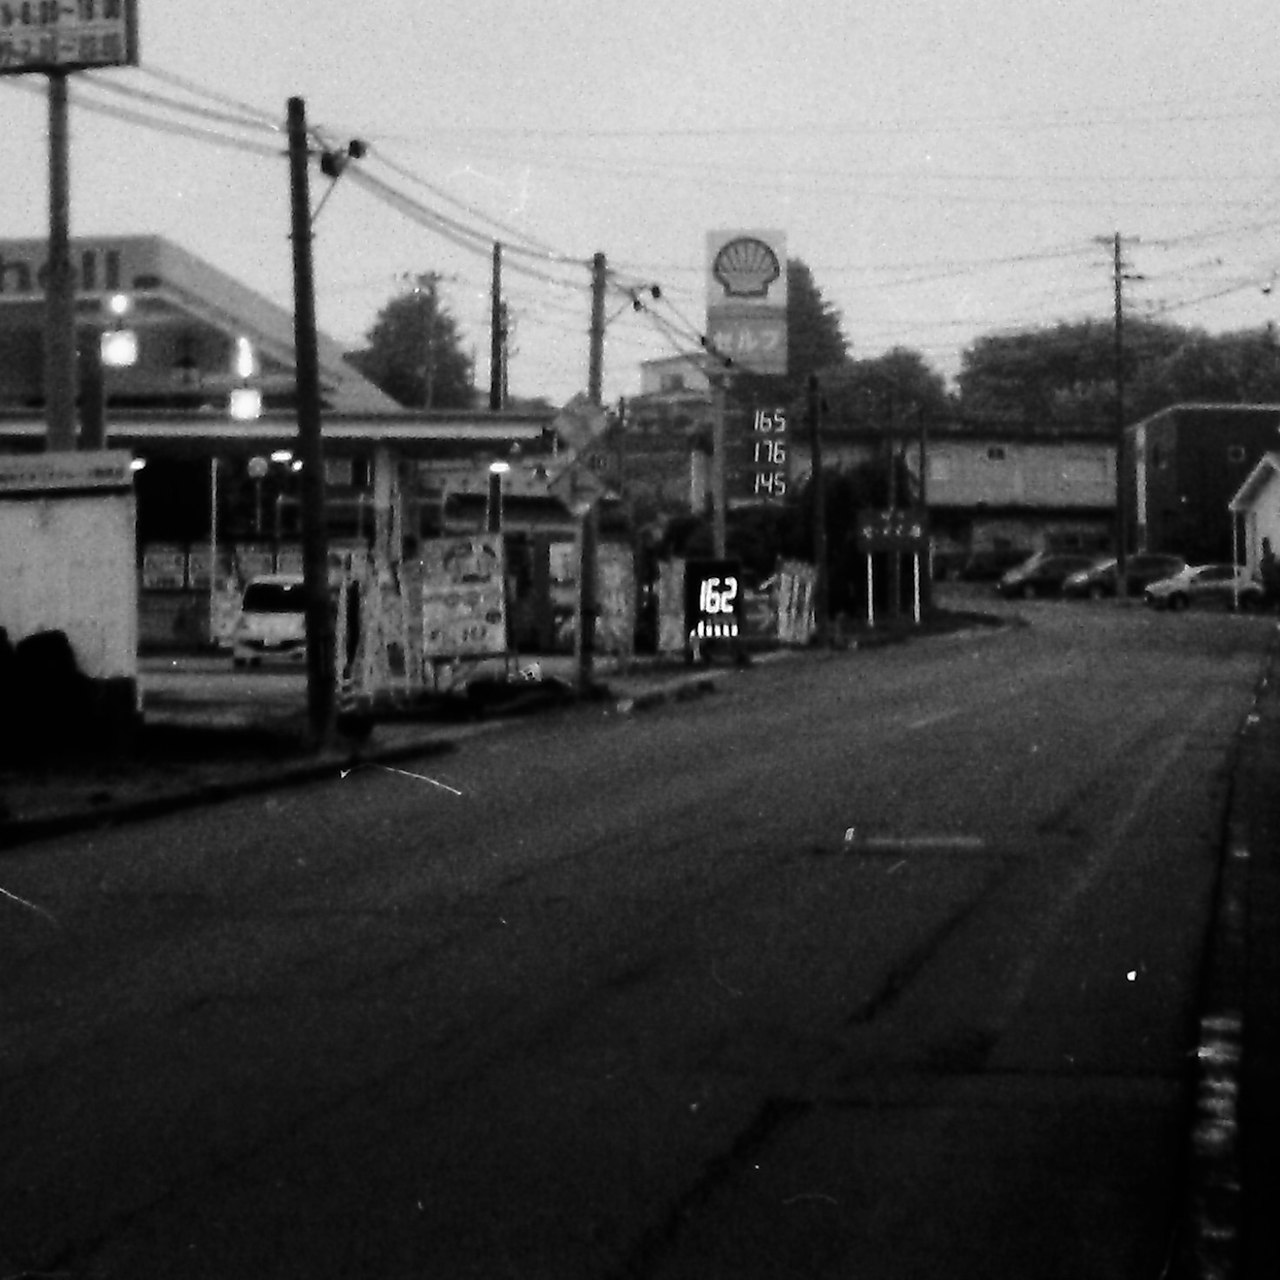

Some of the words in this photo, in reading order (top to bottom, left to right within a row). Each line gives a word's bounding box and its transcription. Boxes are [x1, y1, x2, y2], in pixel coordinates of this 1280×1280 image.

[753, 407, 786, 433] 165
[753, 439, 786, 464] 176
[753, 471, 786, 496] 145
[699, 576, 739, 614] 162
